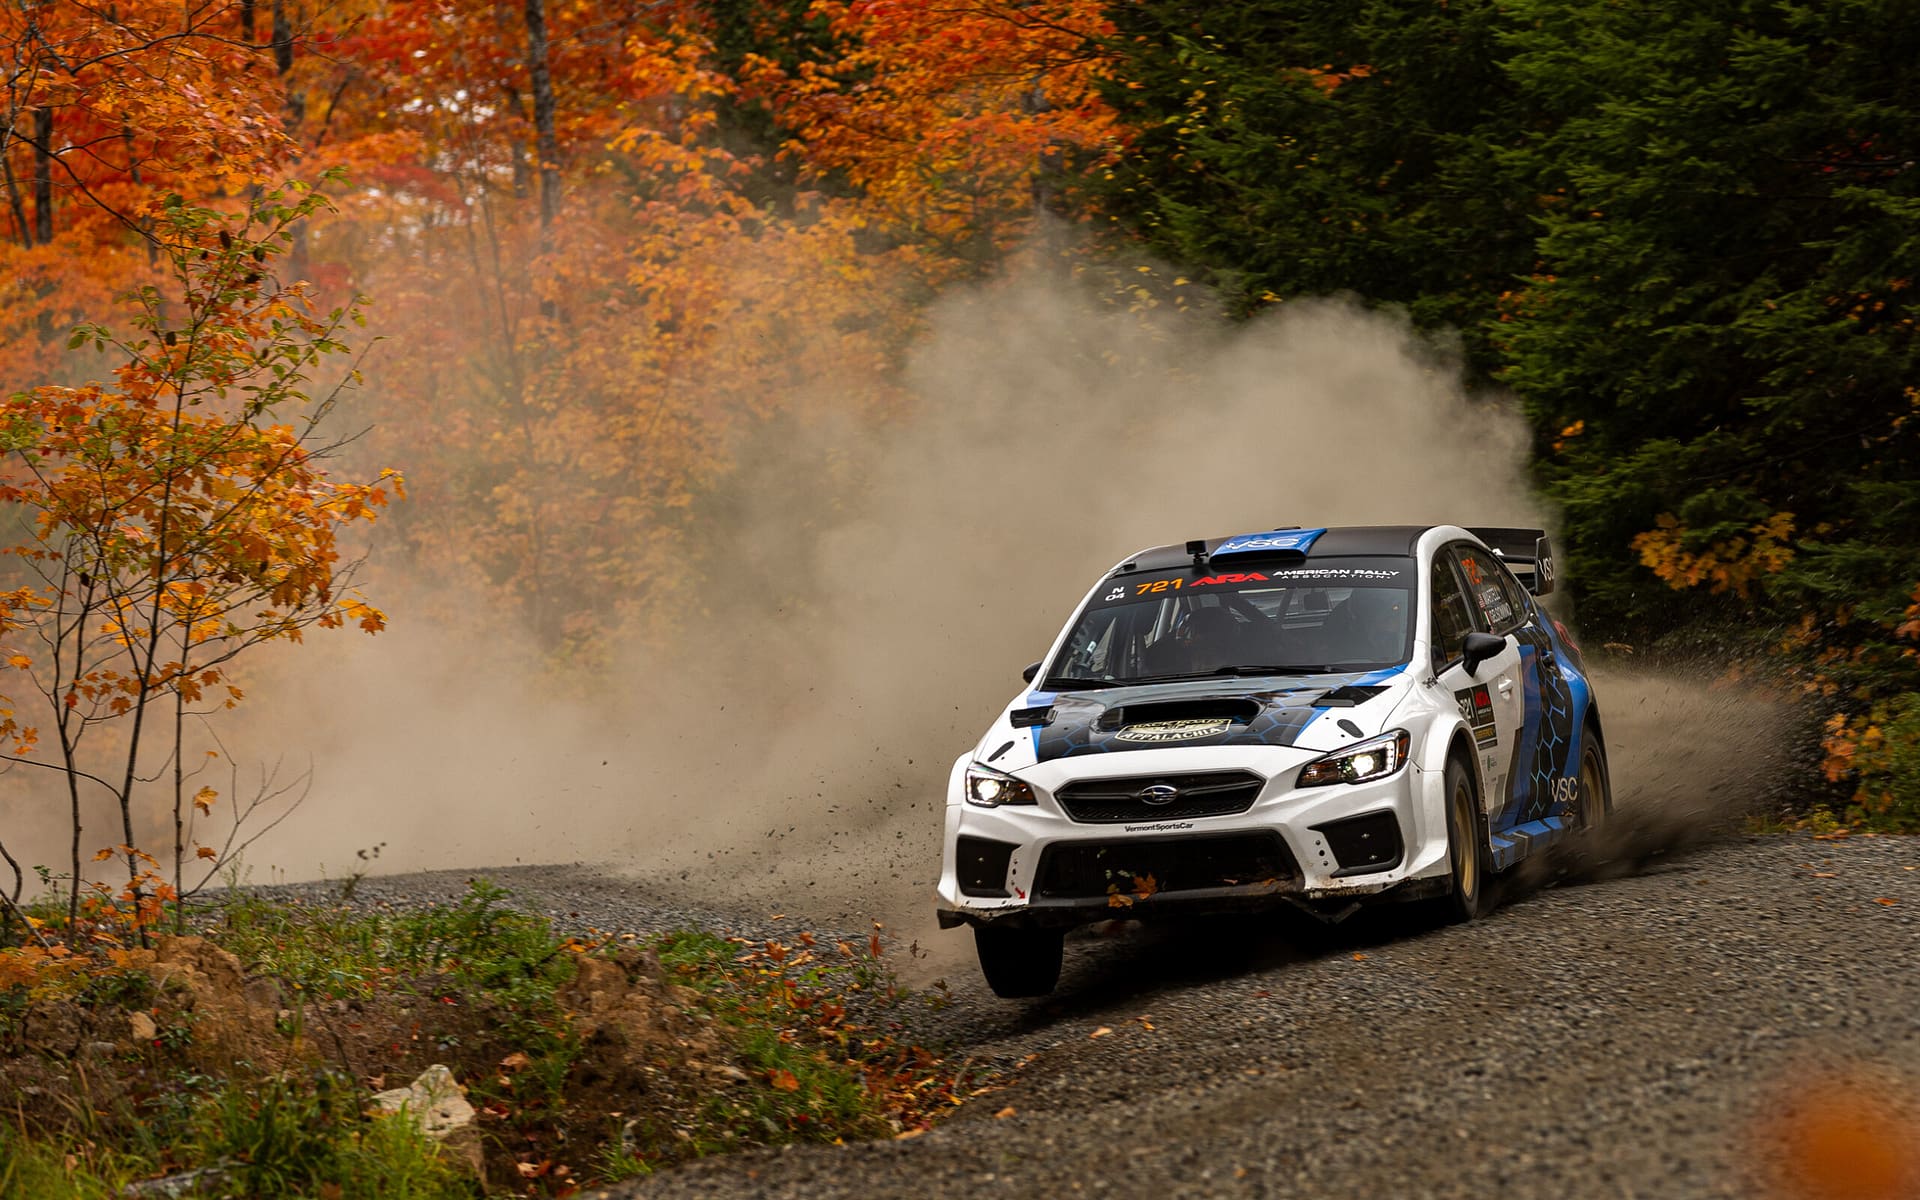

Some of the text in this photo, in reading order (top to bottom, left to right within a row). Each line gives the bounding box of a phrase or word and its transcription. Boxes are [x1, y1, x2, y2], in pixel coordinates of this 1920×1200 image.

[1226, 538, 1299, 549] VSC
[1189, 572, 1270, 586] ARA
[1135, 577, 1184, 596] 721
[1121, 727, 1221, 741] APPALACHIA
[1551, 776, 1578, 802] VSC
[1124, 822, 1194, 832] VermontSportsCar
